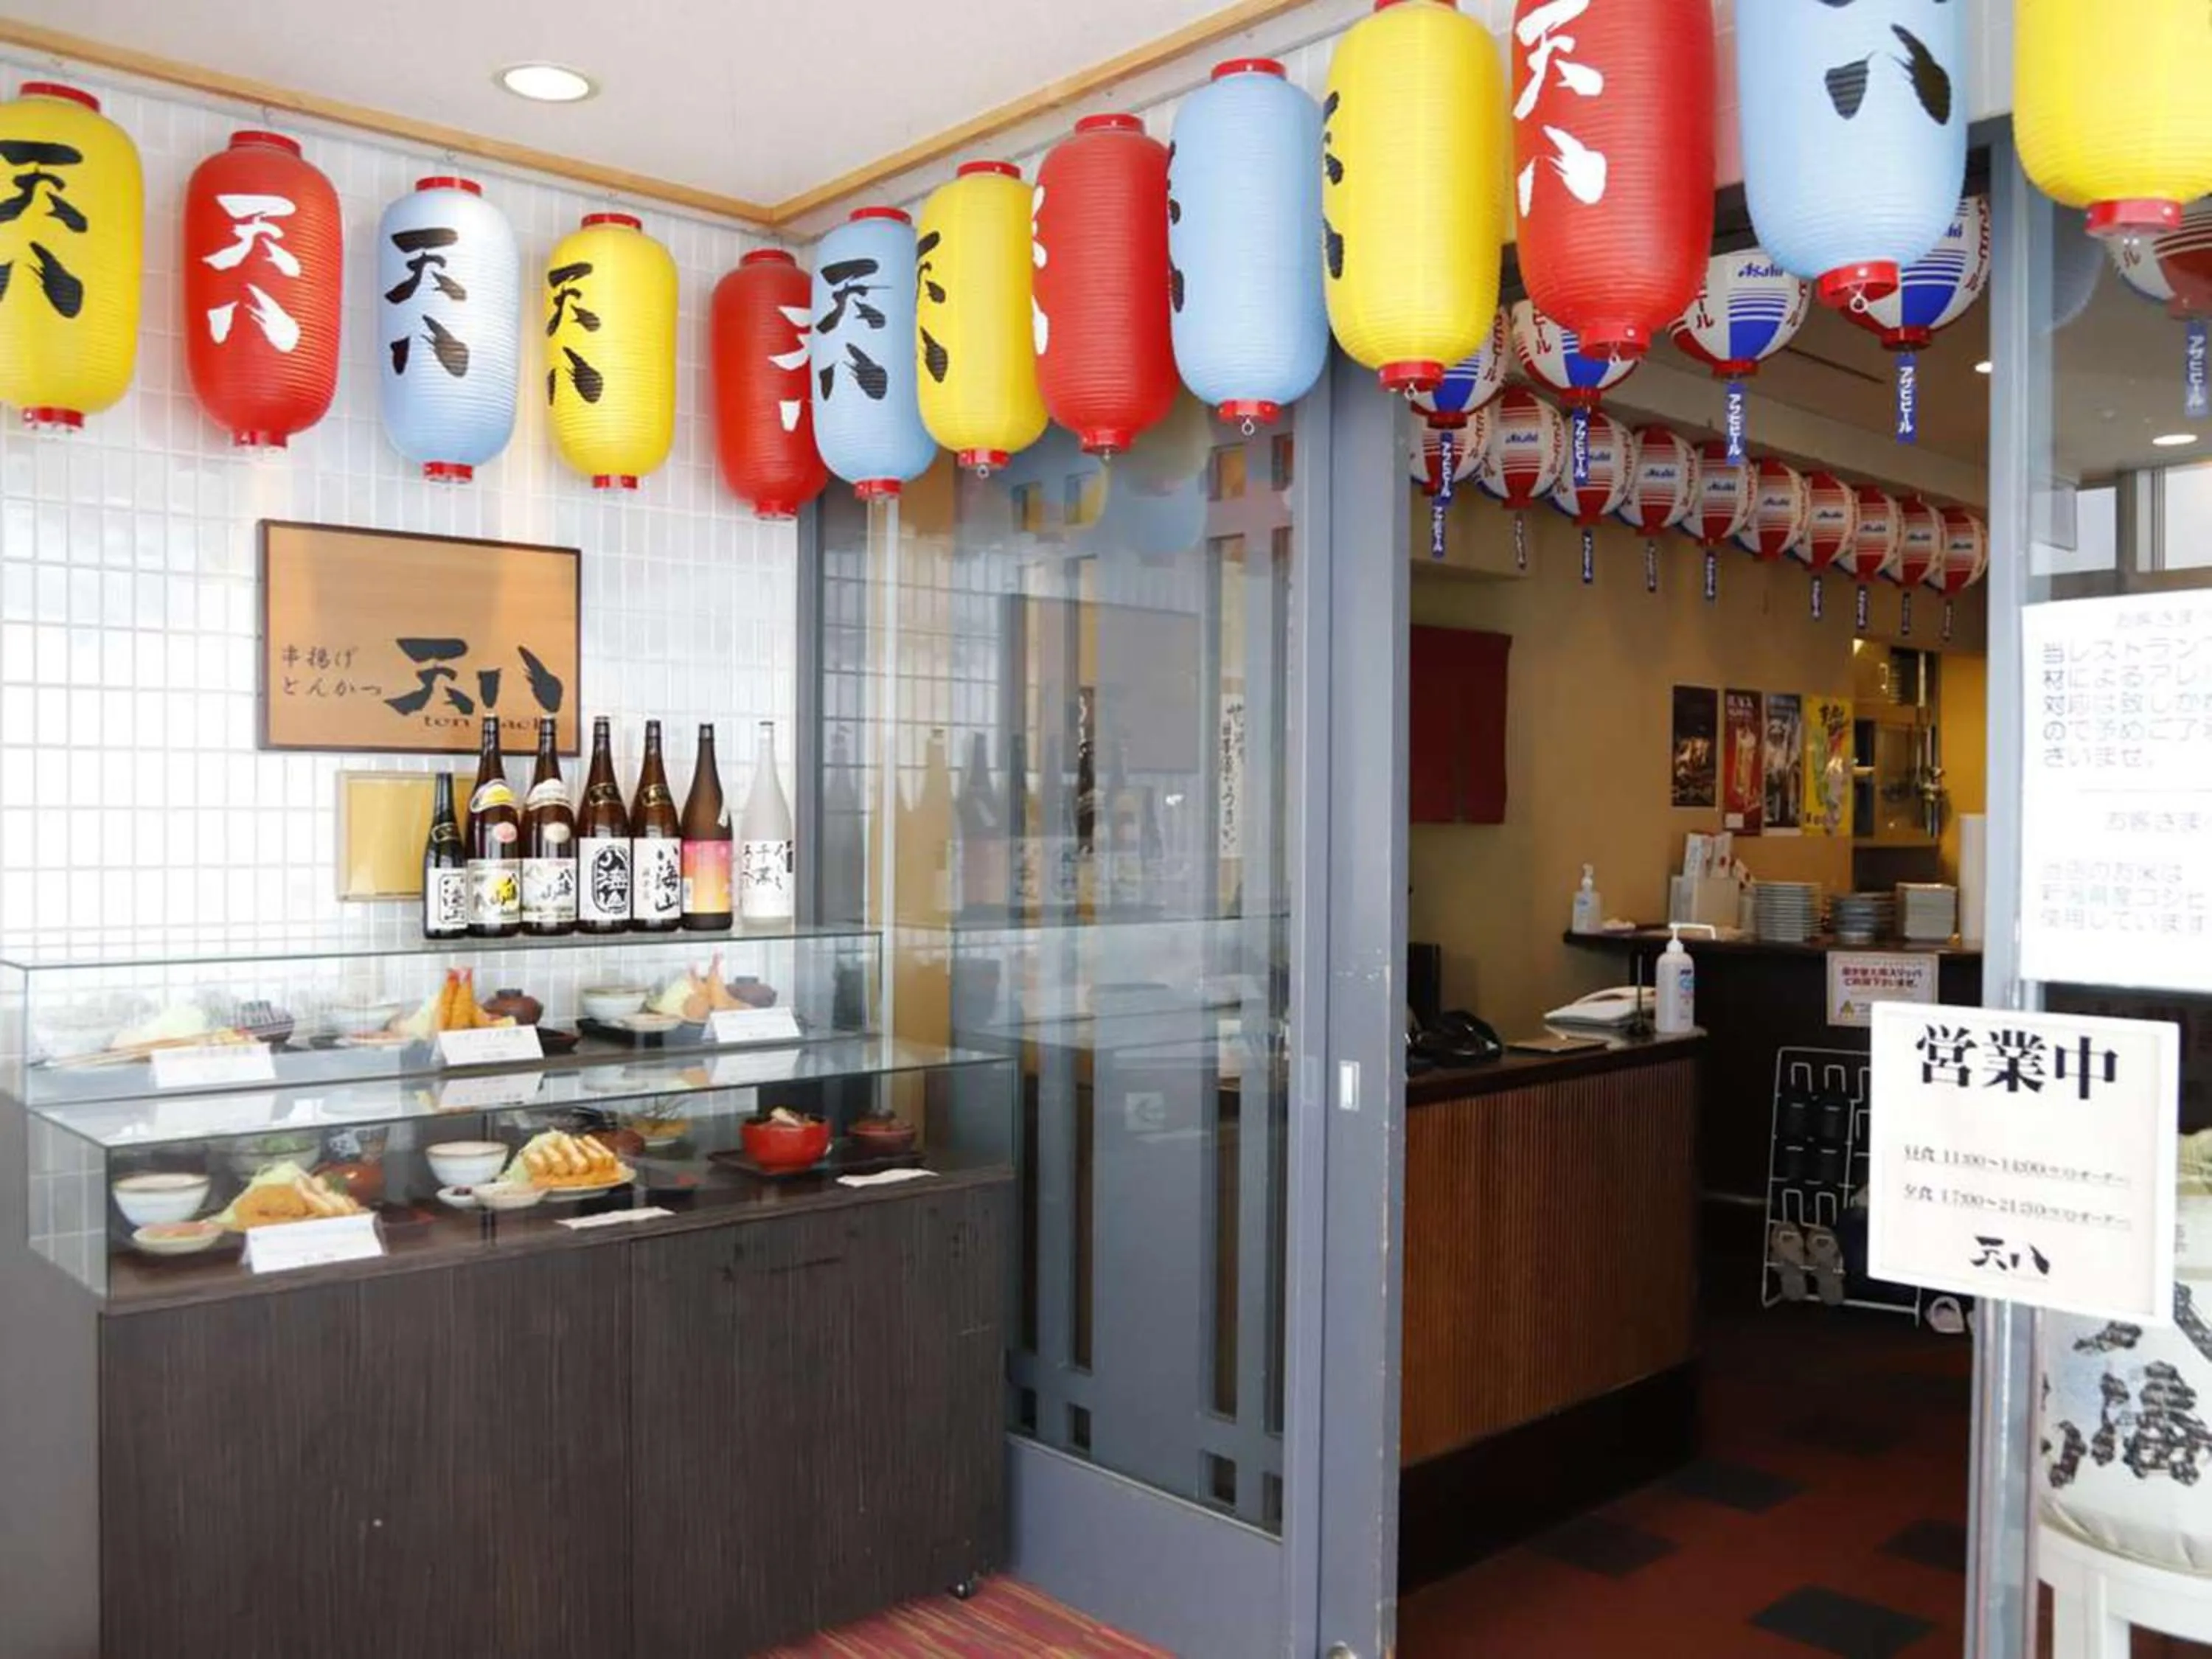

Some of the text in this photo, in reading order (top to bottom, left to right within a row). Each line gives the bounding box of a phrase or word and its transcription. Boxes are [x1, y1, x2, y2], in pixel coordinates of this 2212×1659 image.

[1820, 0, 1952, 125] 八
[0, 140, 88, 319] 天八
[203, 193, 301, 352] 天八
[384, 228, 470, 378] 天八
[547, 262, 604, 405] 天八
[815, 258, 887, 400] 天八
[1899, 366, 1915, 434] アサヒビール
[281, 644, 360, 669] 串揚げ
[281, 676, 382, 698] とんかつ
[383, 637, 564, 717] 天八
[1915, 1023, 2119, 1100] 営業中
[1969, 1235, 2051, 1276] 天八
